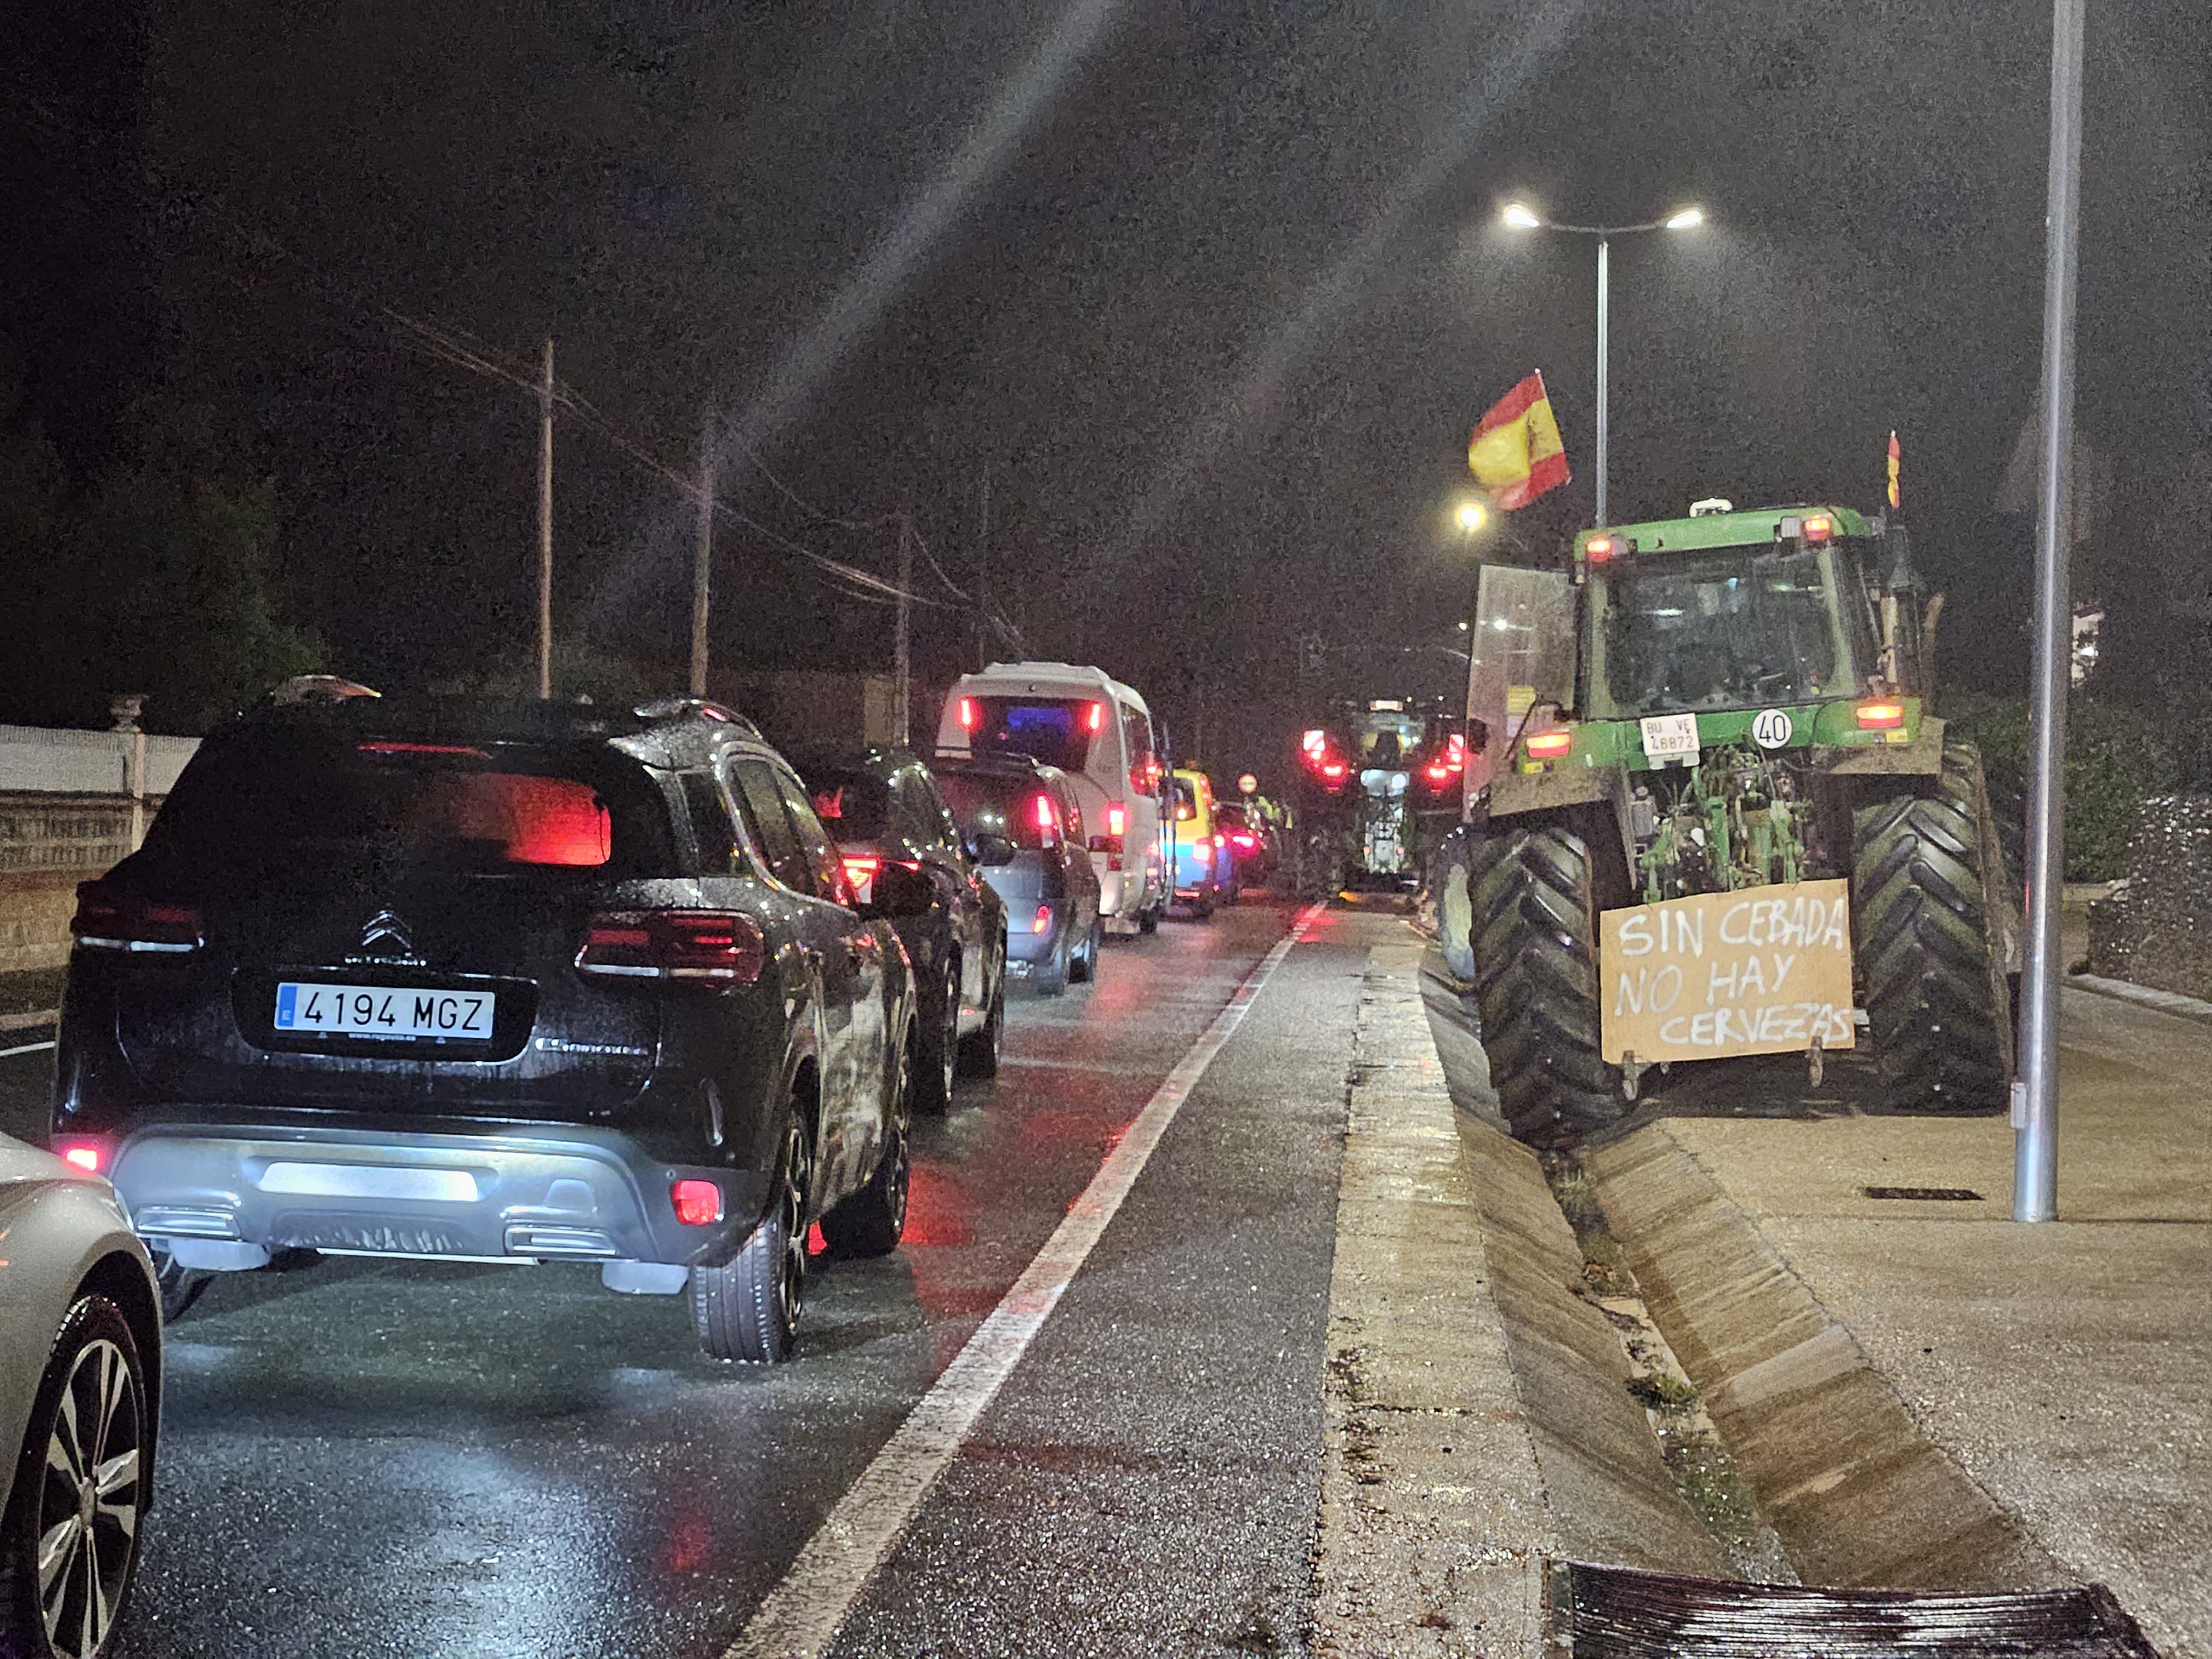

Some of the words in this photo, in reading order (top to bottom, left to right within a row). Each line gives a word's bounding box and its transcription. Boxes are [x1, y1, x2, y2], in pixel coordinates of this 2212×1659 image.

[1647, 721, 1662, 734] BU
[1676, 718, 1691, 731] VE
[1759, 714, 1787, 743] 40
[1618, 907, 1704, 958] SIN
[1720, 896, 1846, 951] CEBADA
[1614, 963, 1683, 1017] NO
[1706, 953, 1795, 1005] HAY
[304, 992, 396, 1027] 4194
[413, 996, 483, 1031] MGZ
[1660, 1002, 1853, 1047] CERVEZAS
